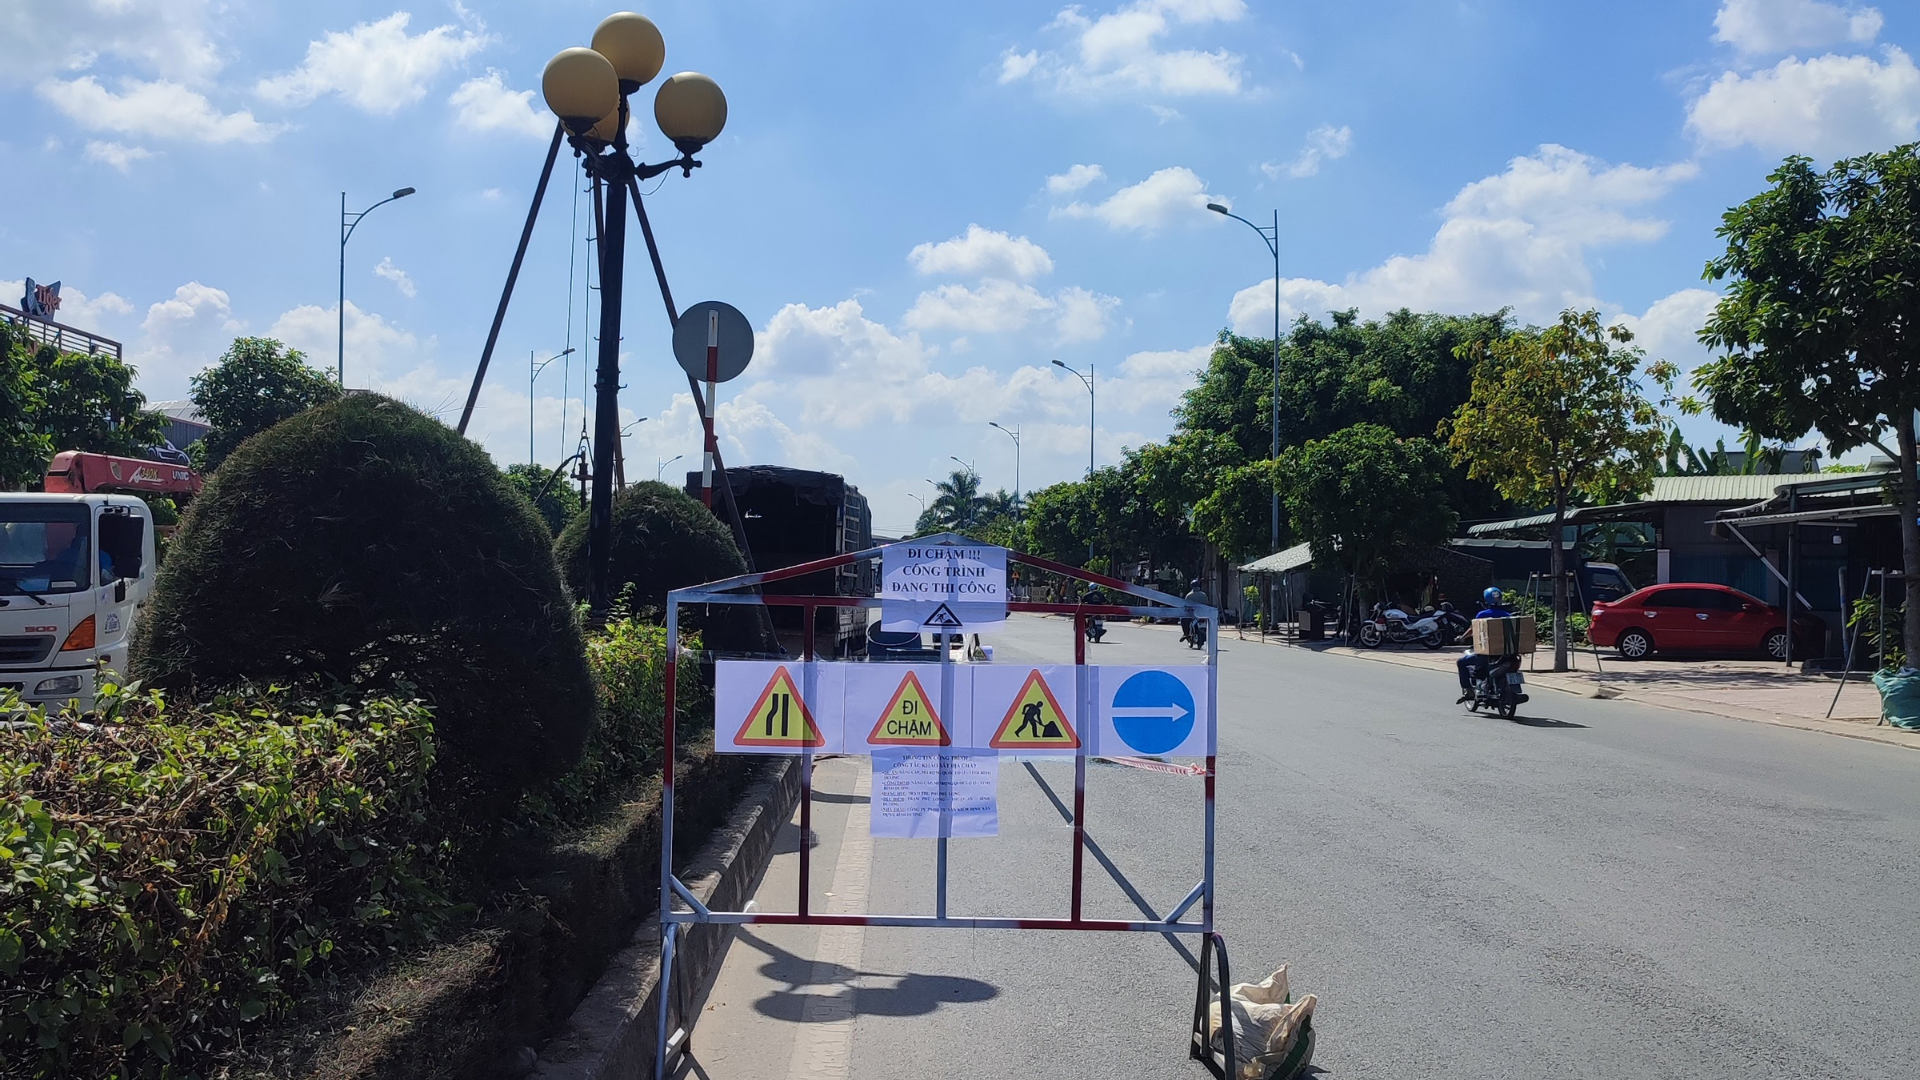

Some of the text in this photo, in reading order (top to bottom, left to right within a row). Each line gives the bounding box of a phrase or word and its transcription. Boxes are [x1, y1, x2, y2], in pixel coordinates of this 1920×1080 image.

[36, 284, 62, 315] Tiger
[908, 548, 981, 562] ĐI CHẬM !!!
[902, 563, 986, 578] CÔNG TRÌNH
[892, 580, 996, 594] ĐANG THI CÔNG
[902, 700, 918, 715] ĐI
[886, 719, 932, 738] CHẬM
